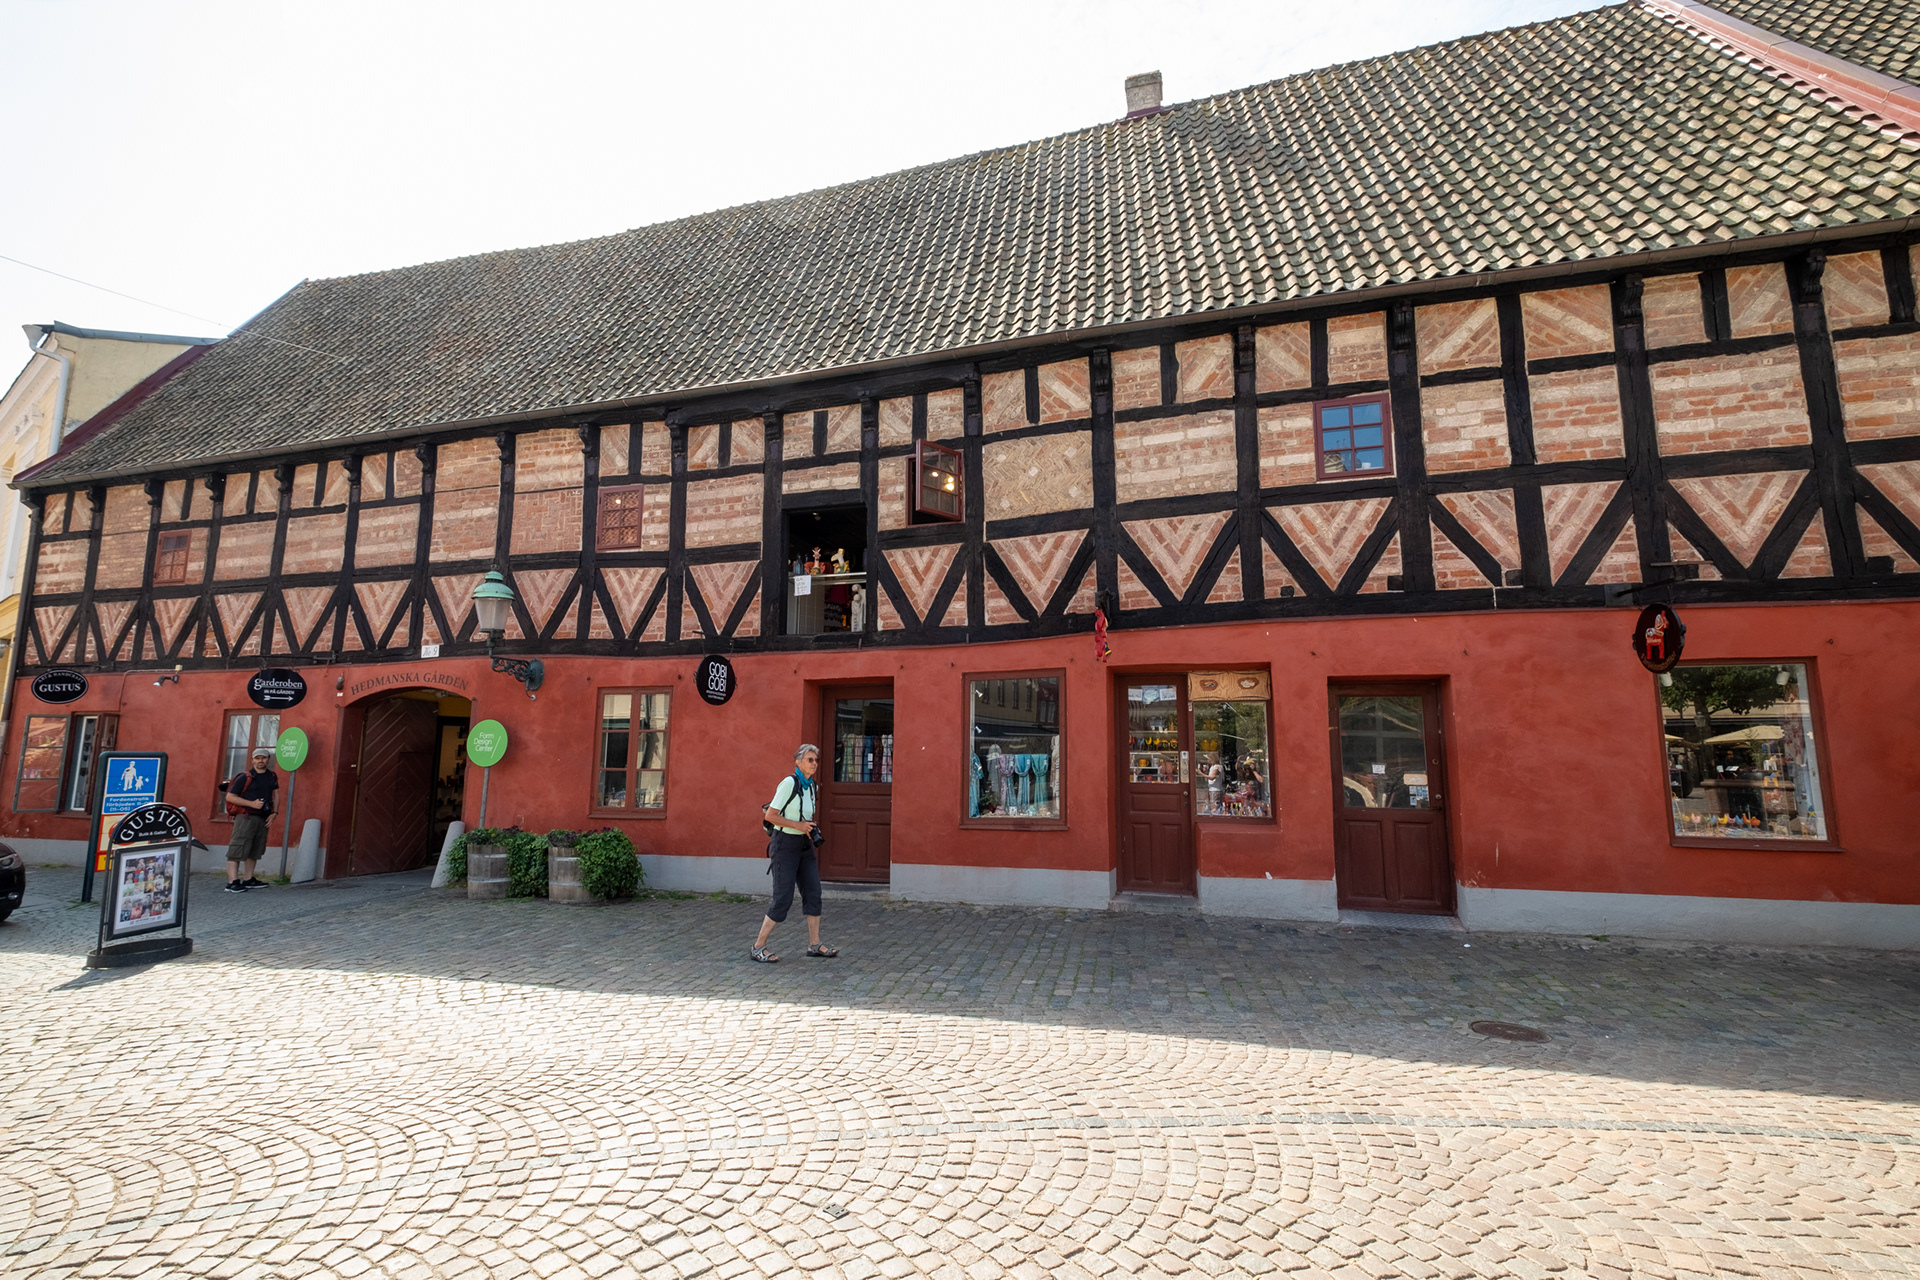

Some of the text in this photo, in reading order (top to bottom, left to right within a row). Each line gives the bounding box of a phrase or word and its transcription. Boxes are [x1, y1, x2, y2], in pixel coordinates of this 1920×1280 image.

[709, 661, 727, 678] GOBI
[39, 683, 81, 692] GUSTUS
[253, 678, 303, 690] garderoben
[351, 670, 468, 695] HEDMANSKA GÅRDEN
[708, 676, 726, 692] GOBI
[474, 738, 493, 746] Design
[120, 810, 185, 841] GUSTUS
